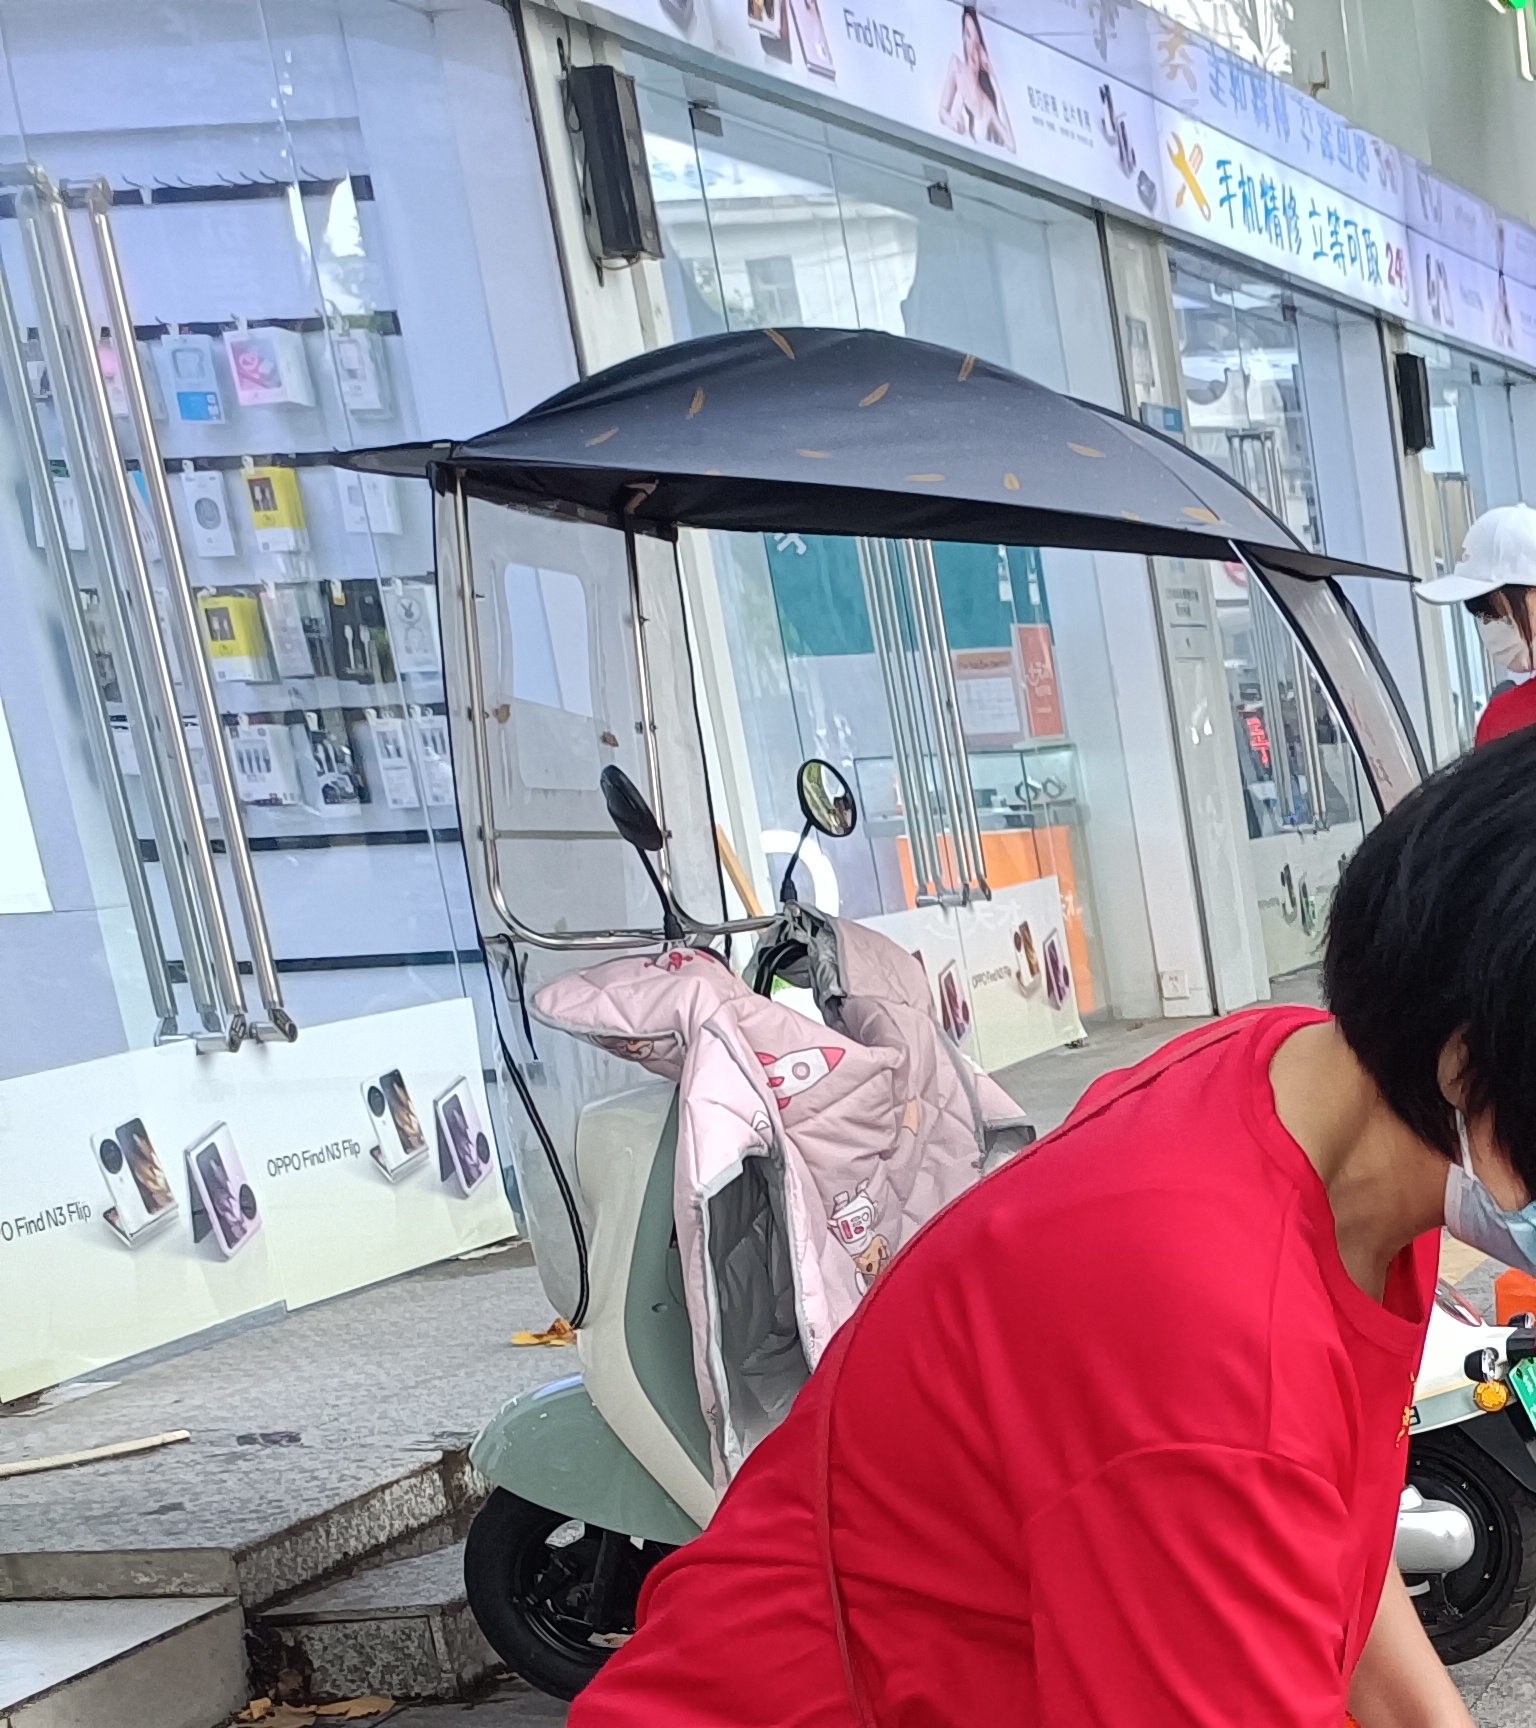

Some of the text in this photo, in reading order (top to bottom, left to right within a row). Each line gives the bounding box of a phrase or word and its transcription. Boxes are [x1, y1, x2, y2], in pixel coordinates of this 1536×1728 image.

[843, 8, 917, 71] Find N3 Flip
[1216, 159, 1302, 255] 手机精修
[1309, 197, 1383, 286] 立等可取
[267, 1139, 362, 1177] OPPO Find N3 Flip
[14, 1216, 46, 1238] Find
[45, 1206, 67, 1229] N3
[66, 1201, 92, 1223] Flip
